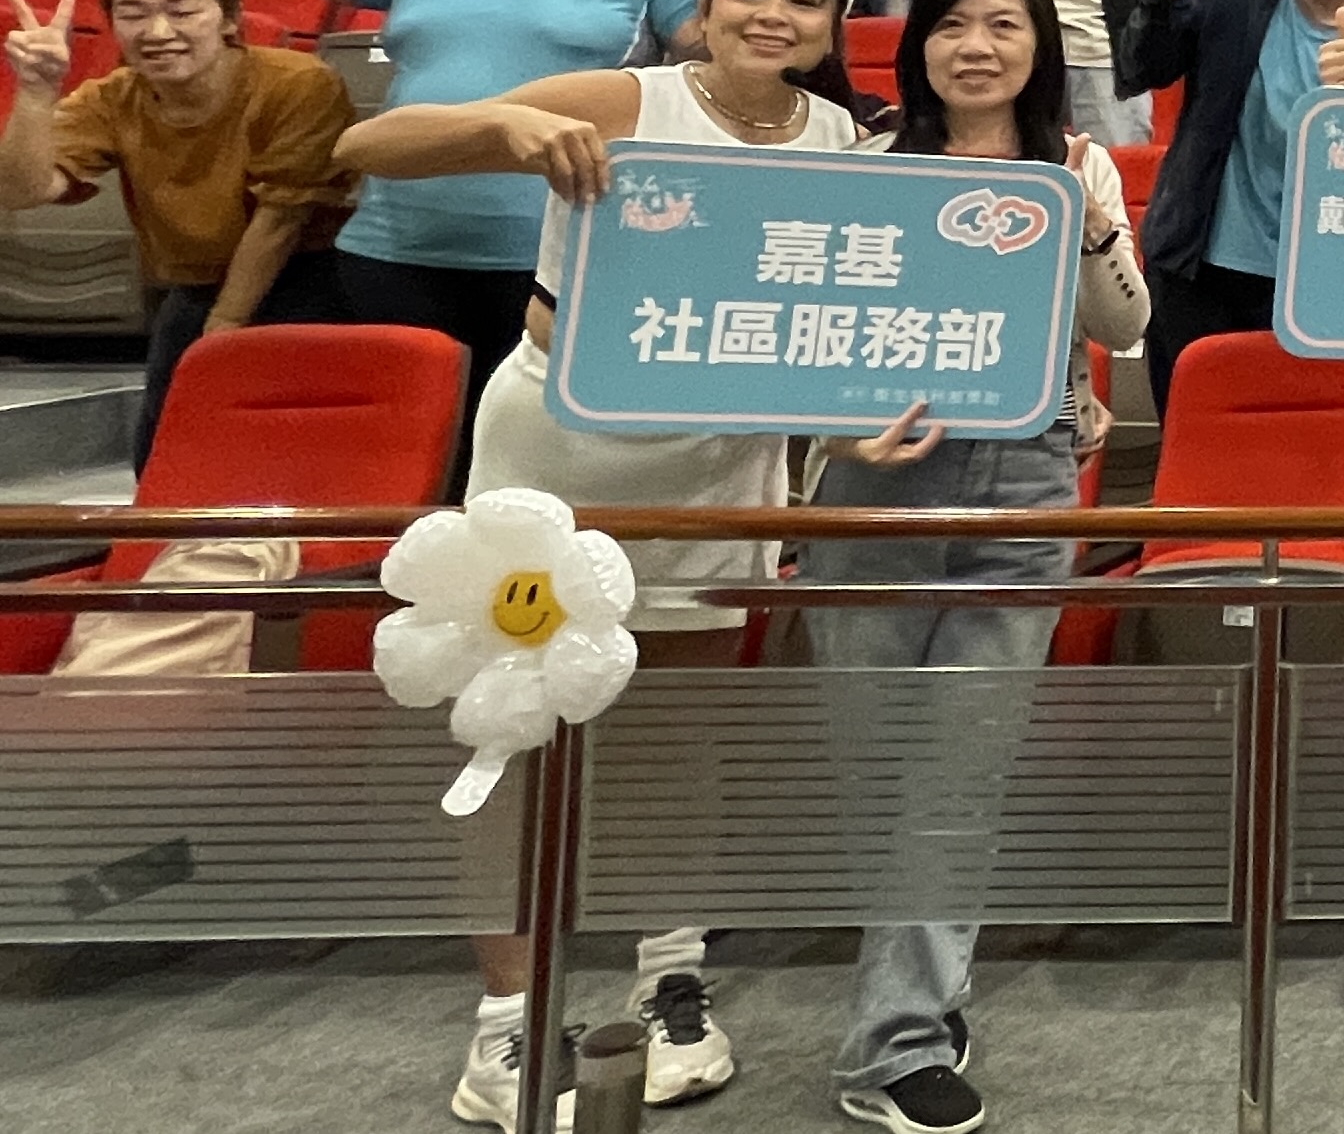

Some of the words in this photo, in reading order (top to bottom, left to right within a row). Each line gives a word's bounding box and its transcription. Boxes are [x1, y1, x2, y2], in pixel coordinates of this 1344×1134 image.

[757, 221, 904, 287] 嘉基
[630, 297, 1005, 372] 社區服務部
